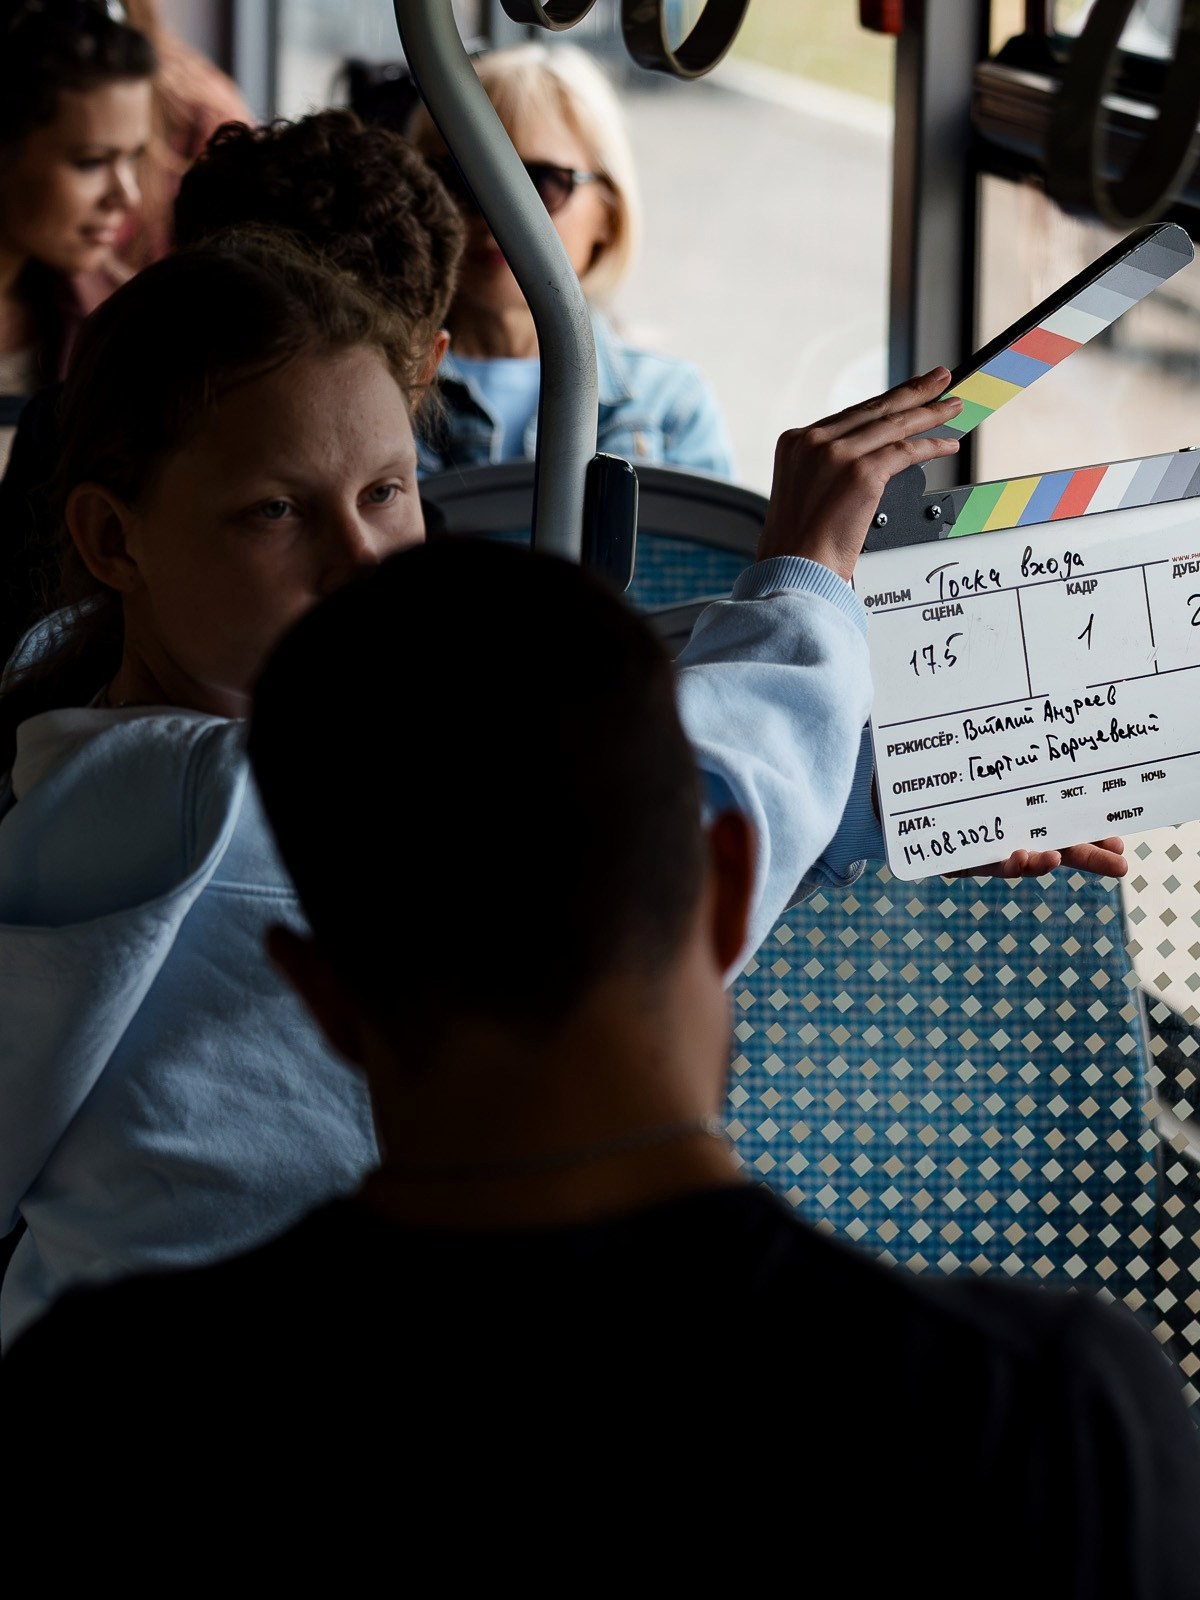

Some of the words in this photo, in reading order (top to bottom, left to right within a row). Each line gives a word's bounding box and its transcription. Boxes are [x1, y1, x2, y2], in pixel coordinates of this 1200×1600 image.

[926, 562, 1001, 602] Точка
[1021, 546, 1084, 581] входа
[864, 589, 912, 607] ФИЛЬМ
[1066, 579, 1098, 595] КАДР
[922, 603, 964, 622] СЦЕНА
[1078, 613, 1094, 650] 1
[909, 632, 963, 677] 17.5
[1043, 685, 1117, 724] Андреев
[886, 728, 959, 757] РЕЖИССЁР:
[892, 771, 964, 795] ОПЕРАТОР:
[1026, 794, 1048, 807] ИНТ.
[1060, 786, 1087, 799] ЭКСТ.
[1102, 778, 1127, 792] ДЕНЬ
[1140, 769, 1167, 783] НОЧЬ
[898, 816, 936, 836] ДАТА:
[1106, 807, 1144, 822] ФИЛЬТР
[1030, 827, 1048, 839] FPS
